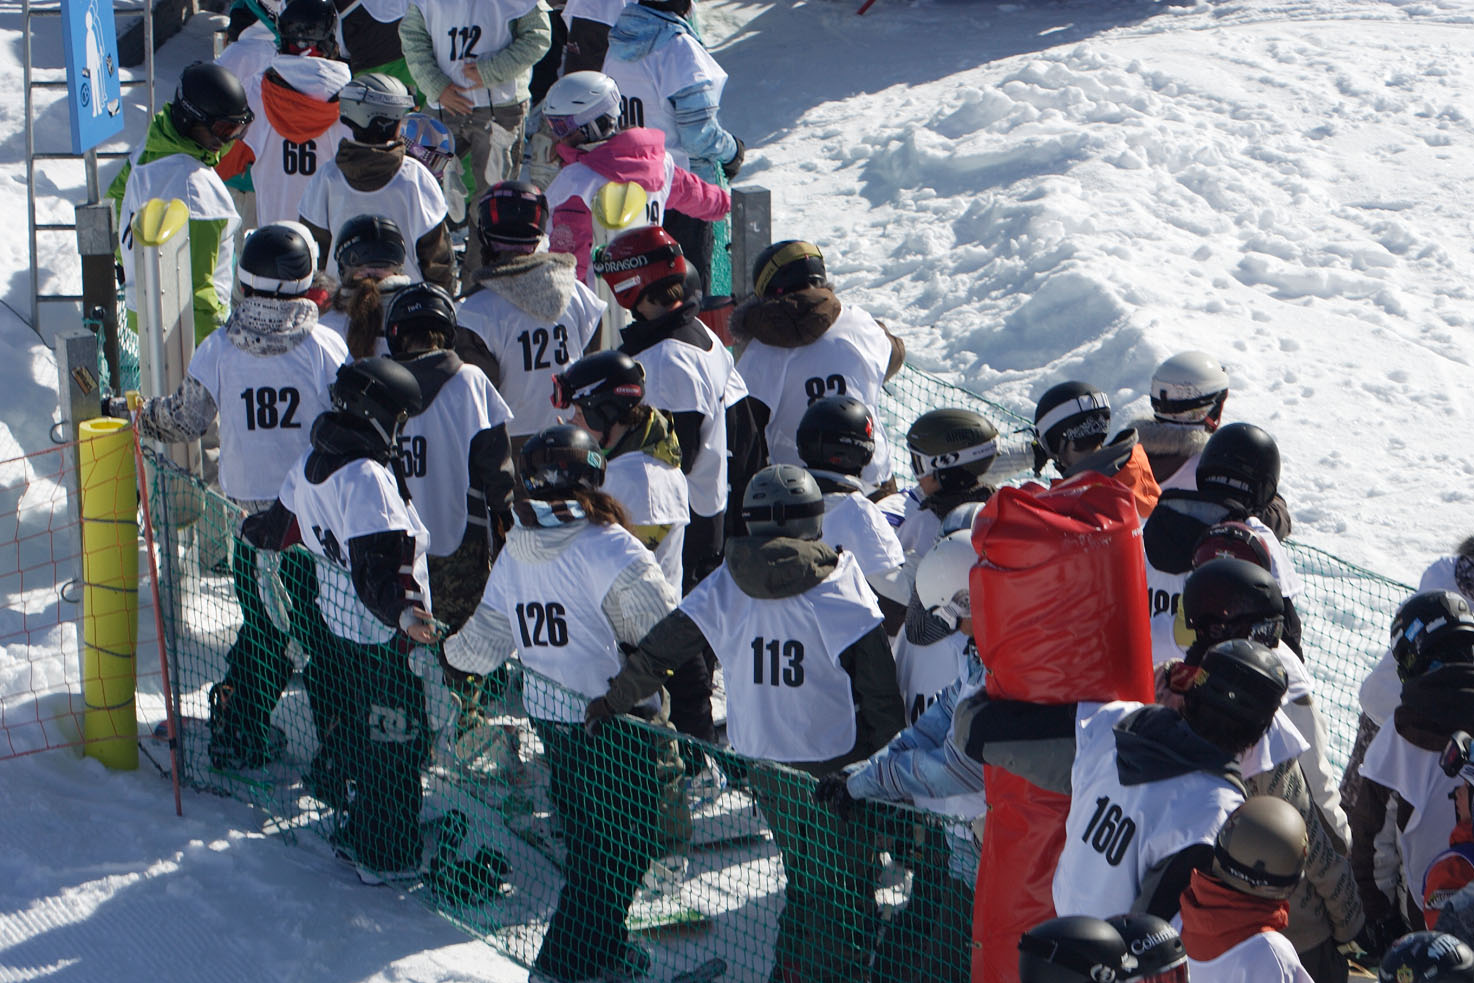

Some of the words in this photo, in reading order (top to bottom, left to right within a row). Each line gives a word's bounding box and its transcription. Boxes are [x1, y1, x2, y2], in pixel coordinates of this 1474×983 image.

[448, 25, 481, 61] 112
[282, 139, 317, 175] 66
[604, 255, 649, 273] DRAGON
[517, 323, 571, 372] 123
[240, 386, 302, 431] 182
[515, 602, 568, 647] 126
[751, 637, 805, 688] 113
[1081, 795, 1136, 867] 160
